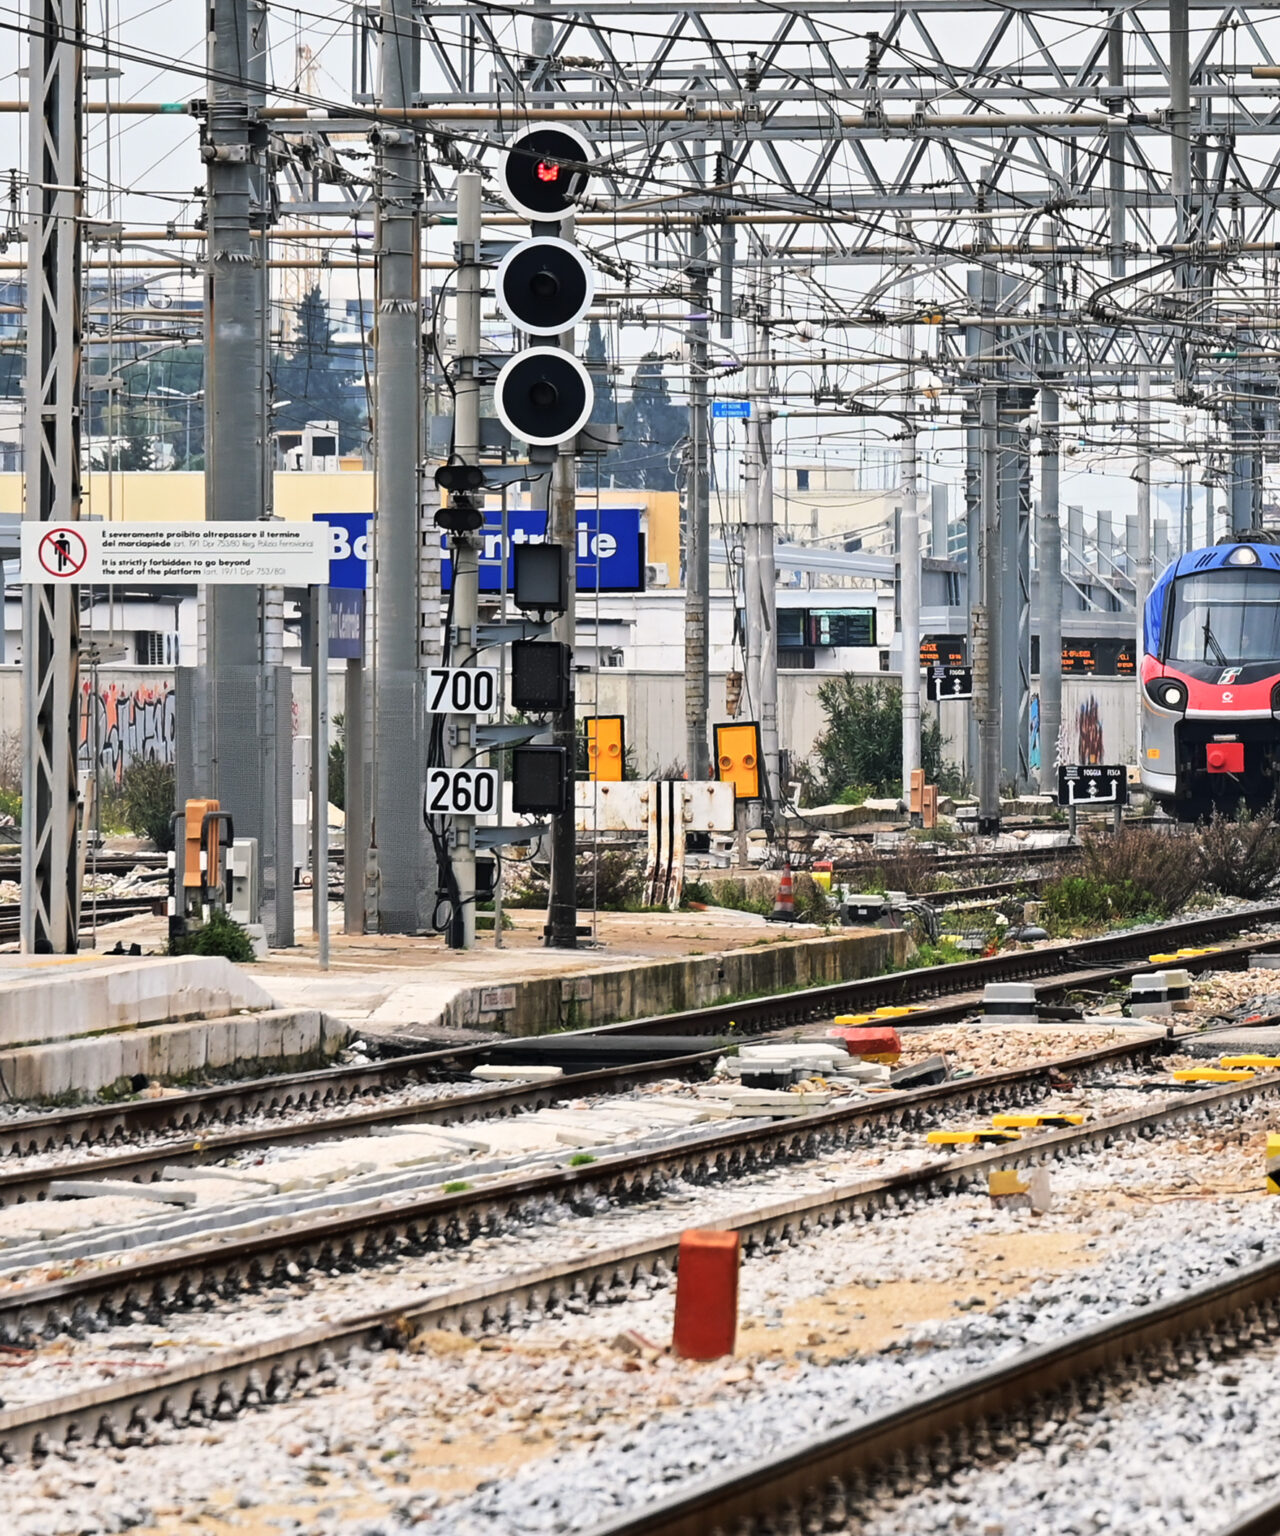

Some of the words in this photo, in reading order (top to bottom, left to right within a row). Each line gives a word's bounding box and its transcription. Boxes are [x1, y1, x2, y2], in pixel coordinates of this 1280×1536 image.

[166, 530, 200, 539] proibito
[202, 530, 257, 539] oltrepassare
[260, 530, 264, 538] il
[267, 530, 300, 538] termine
[118, 540, 171, 548] marciapiede
[119, 559, 147, 568] strictly
[205, 560, 216, 568] go
[218, 558, 251, 568] beyond
[164, 568, 202, 576] platform
[430, 670, 494, 711] 700
[1083, 768, 1102, 776] FOGGIA
[1106, 768, 1121, 776] FESCA
[430, 771, 494, 812] 260
